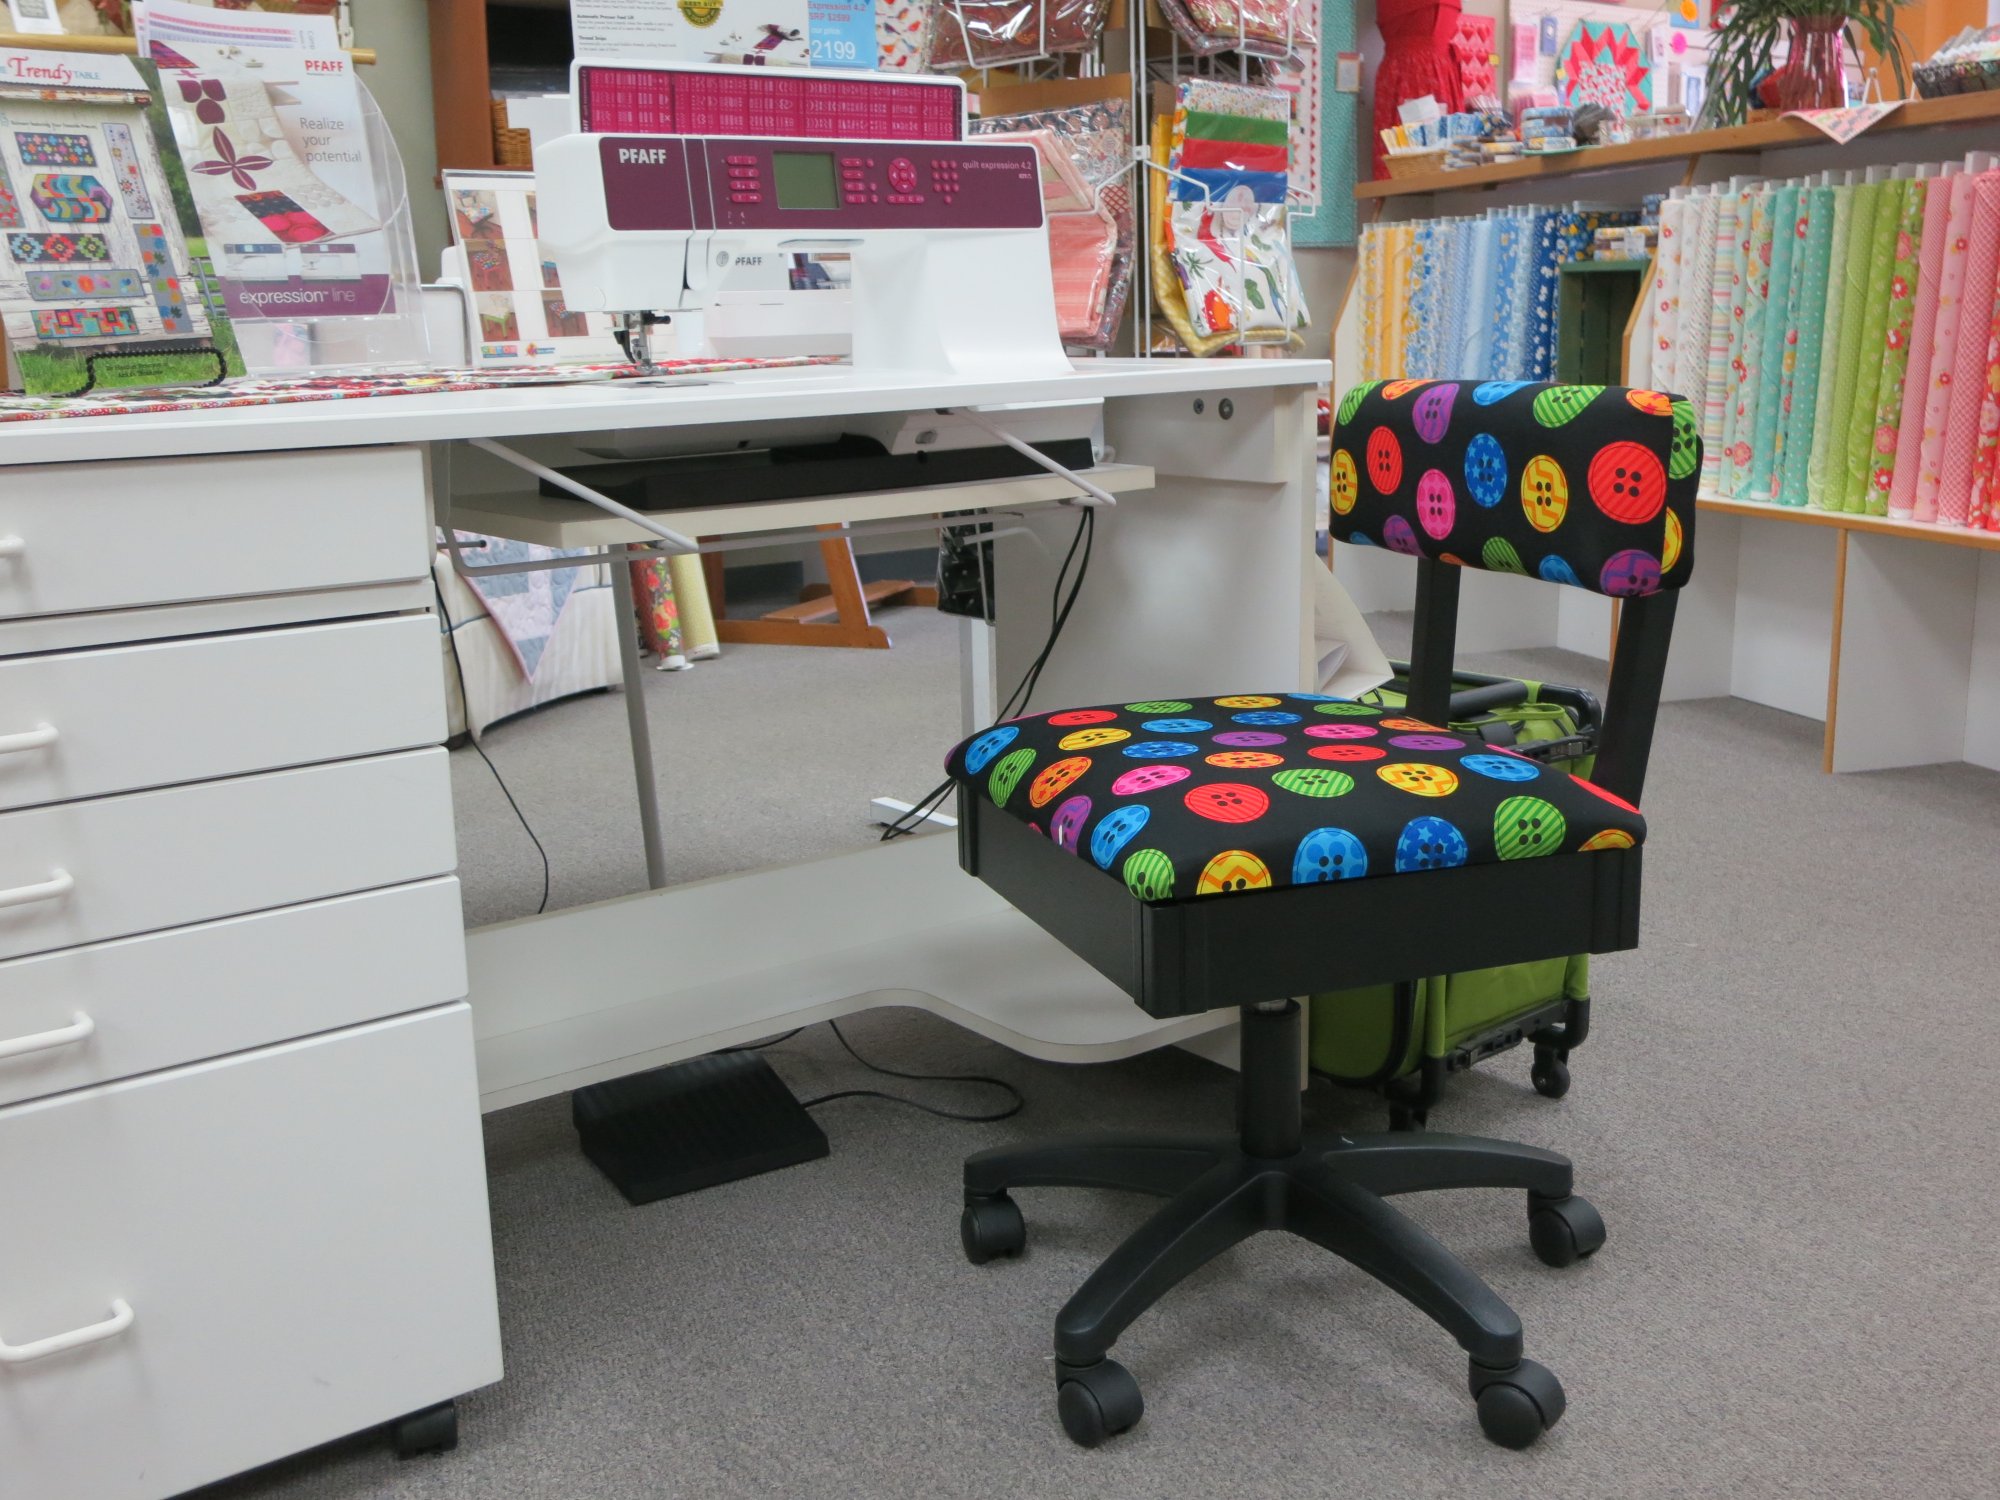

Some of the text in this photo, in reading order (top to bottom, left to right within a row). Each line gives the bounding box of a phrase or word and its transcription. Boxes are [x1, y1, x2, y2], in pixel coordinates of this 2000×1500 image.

[811, 39, 856, 60] 2199
[7, 56, 73, 85] Trendy
[74, 71, 101, 80] TABLE
[304, 60, 344, 72] PFAFF
[300, 117, 345, 130] Realize
[302, 135, 332, 149] your
[306, 150, 363, 163] potential
[618, 148, 668, 165] PFAFF
[962, 160, 980, 170] quilt
[980, 161, 1020, 171] expression
[735, 257, 763, 266] PFAFF
[331, 288, 356, 302] line
